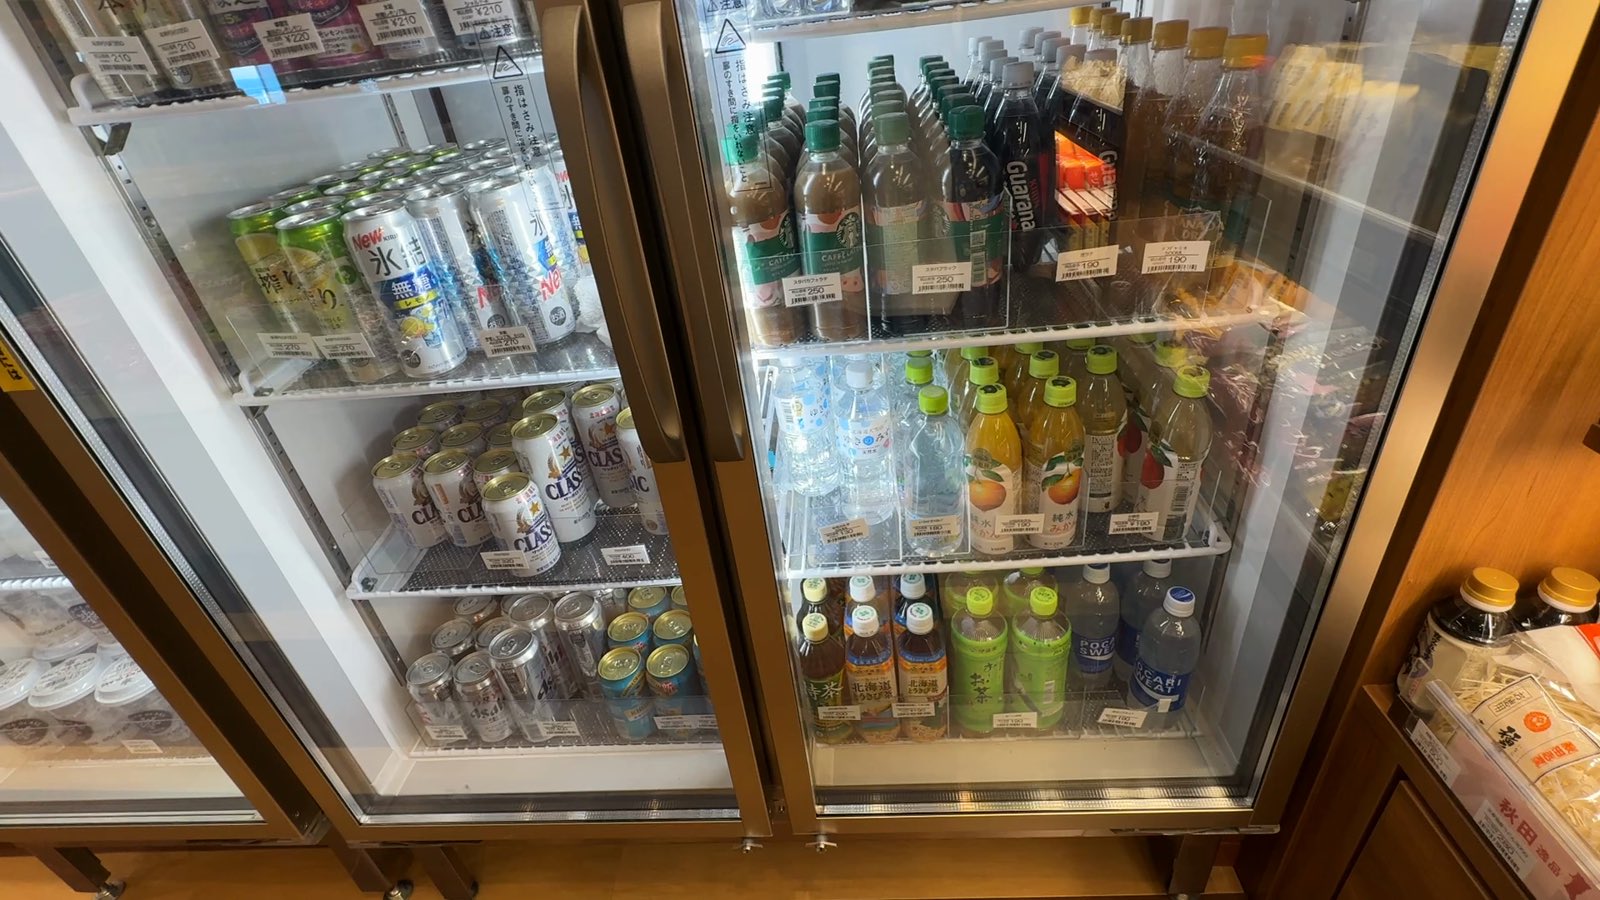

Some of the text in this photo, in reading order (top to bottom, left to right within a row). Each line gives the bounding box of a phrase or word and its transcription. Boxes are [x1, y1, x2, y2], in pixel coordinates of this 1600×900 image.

[474, 4, 502, 17] ¥210
[390, 16, 417, 27] ¥210
[490, 24, 514, 38] 注意
[284, 32, 310, 43] ¥220
[178, 42, 196, 52] 210
[112, 54, 132, 63] 210
[514, 84, 542, 158] 指はさみ注意
[1006, 161, 1036, 232] Guarana
[351, 226, 385, 251] New
[367, 236, 427, 277] 氷結
[1168, 255, 1187, 264] 190
[1081, 261, 1100, 269] 190
[936, 276, 954, 284] 250
[391, 273, 432, 299] 無糖
[807, 287, 825, 295] 250
[503, 337, 519, 346] 270
[1052, 511, 1074, 522] 純水
[851, 680, 892, 693] 北海道
[908, 679, 939, 688] 北海道
